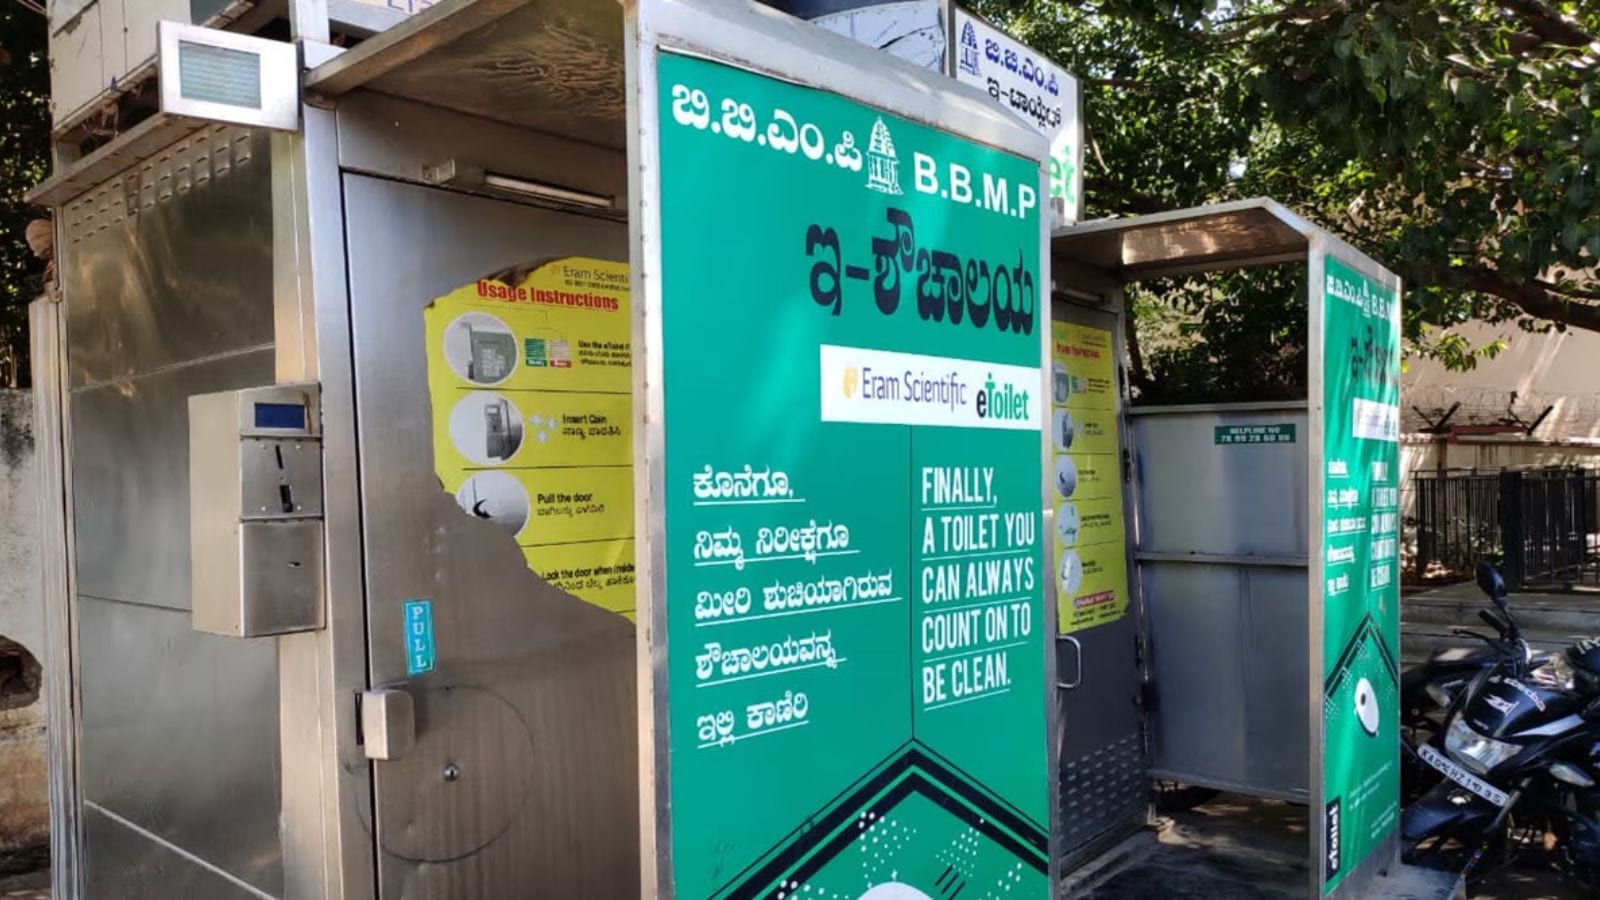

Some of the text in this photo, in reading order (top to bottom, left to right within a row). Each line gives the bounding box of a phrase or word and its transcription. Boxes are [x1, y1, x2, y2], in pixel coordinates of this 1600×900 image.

[985, 38, 1059, 97] ಬಿ.ಬಿ.ಎಂ.ಪಿ
[671, 83, 864, 172] ಬಿ.ಬಿ.ಎಂ.ಪಿ
[914, 151, 1037, 220] B.B.M.P
[477, 280, 619, 310] Usage Instructions
[564, 266, 592, 280] Eram
[805, 207, 1034, 336] ಇ-ಶೌಚಾಲಯ
[863, 366, 1030, 420] Eram Scientific eToilet
[562, 413, 607, 424] Insert Coin
[537, 492, 593, 504] Pull the door
[693, 464, 794, 499] ಕೊನೆಗೂ,
[922, 467, 998, 505] FINALLY,
[694, 518, 851, 570] ನಿಮ್ಮ ನಿರೀಕ್ಷೆಗೂ
[923, 511, 1035, 554] A TOILET YOU
[561, 569, 573, 578] the
[575, 567, 592, 577] door
[694, 569, 894, 621] ಮೀರಿ ಶುಚಿಯಾಗಿರುವ
[922, 569, 960, 605] CAN
[966, 556, 1035, 600] ALWAYS
[412, 606, 427, 668] PULL
[922, 612, 980, 654] COUNT
[985, 606, 1008, 641] ON
[1011, 602, 1031, 637] TO
[923, 652, 1012, 704] BE CLEAN.
[696, 709, 736, 748] ಇಲ್ಲಿ
